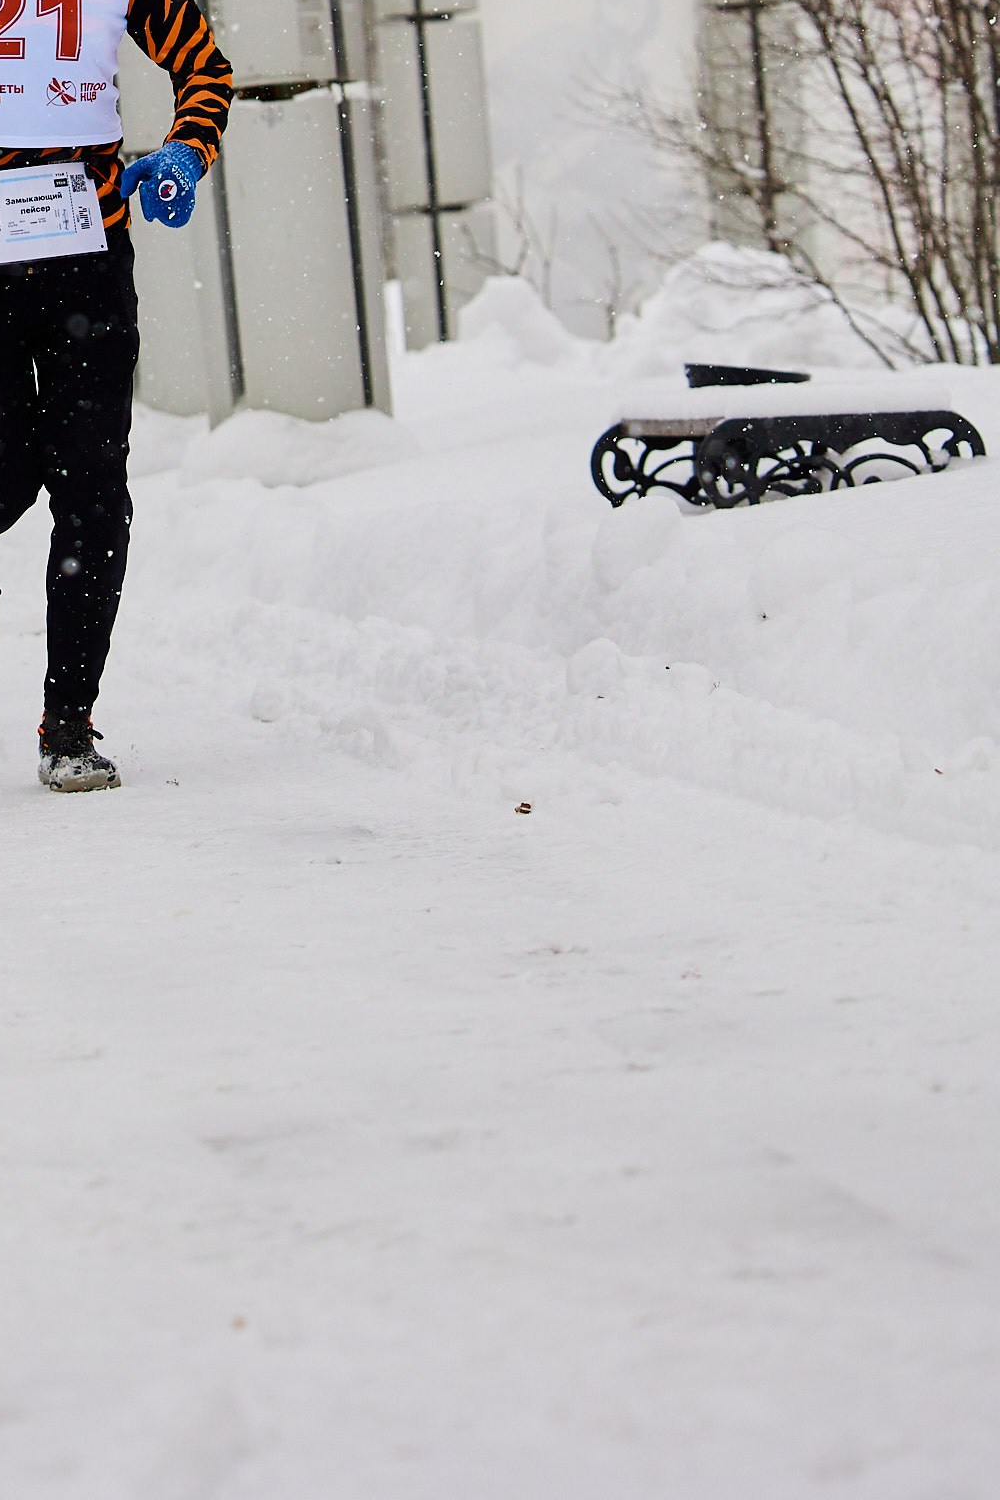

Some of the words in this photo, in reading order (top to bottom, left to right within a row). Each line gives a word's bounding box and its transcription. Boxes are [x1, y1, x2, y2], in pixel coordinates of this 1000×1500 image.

[80, 91, 97, 102] НЦВ
[5, 192, 63, 206] Замыкающий
[20, 205, 51, 215] пейсер
